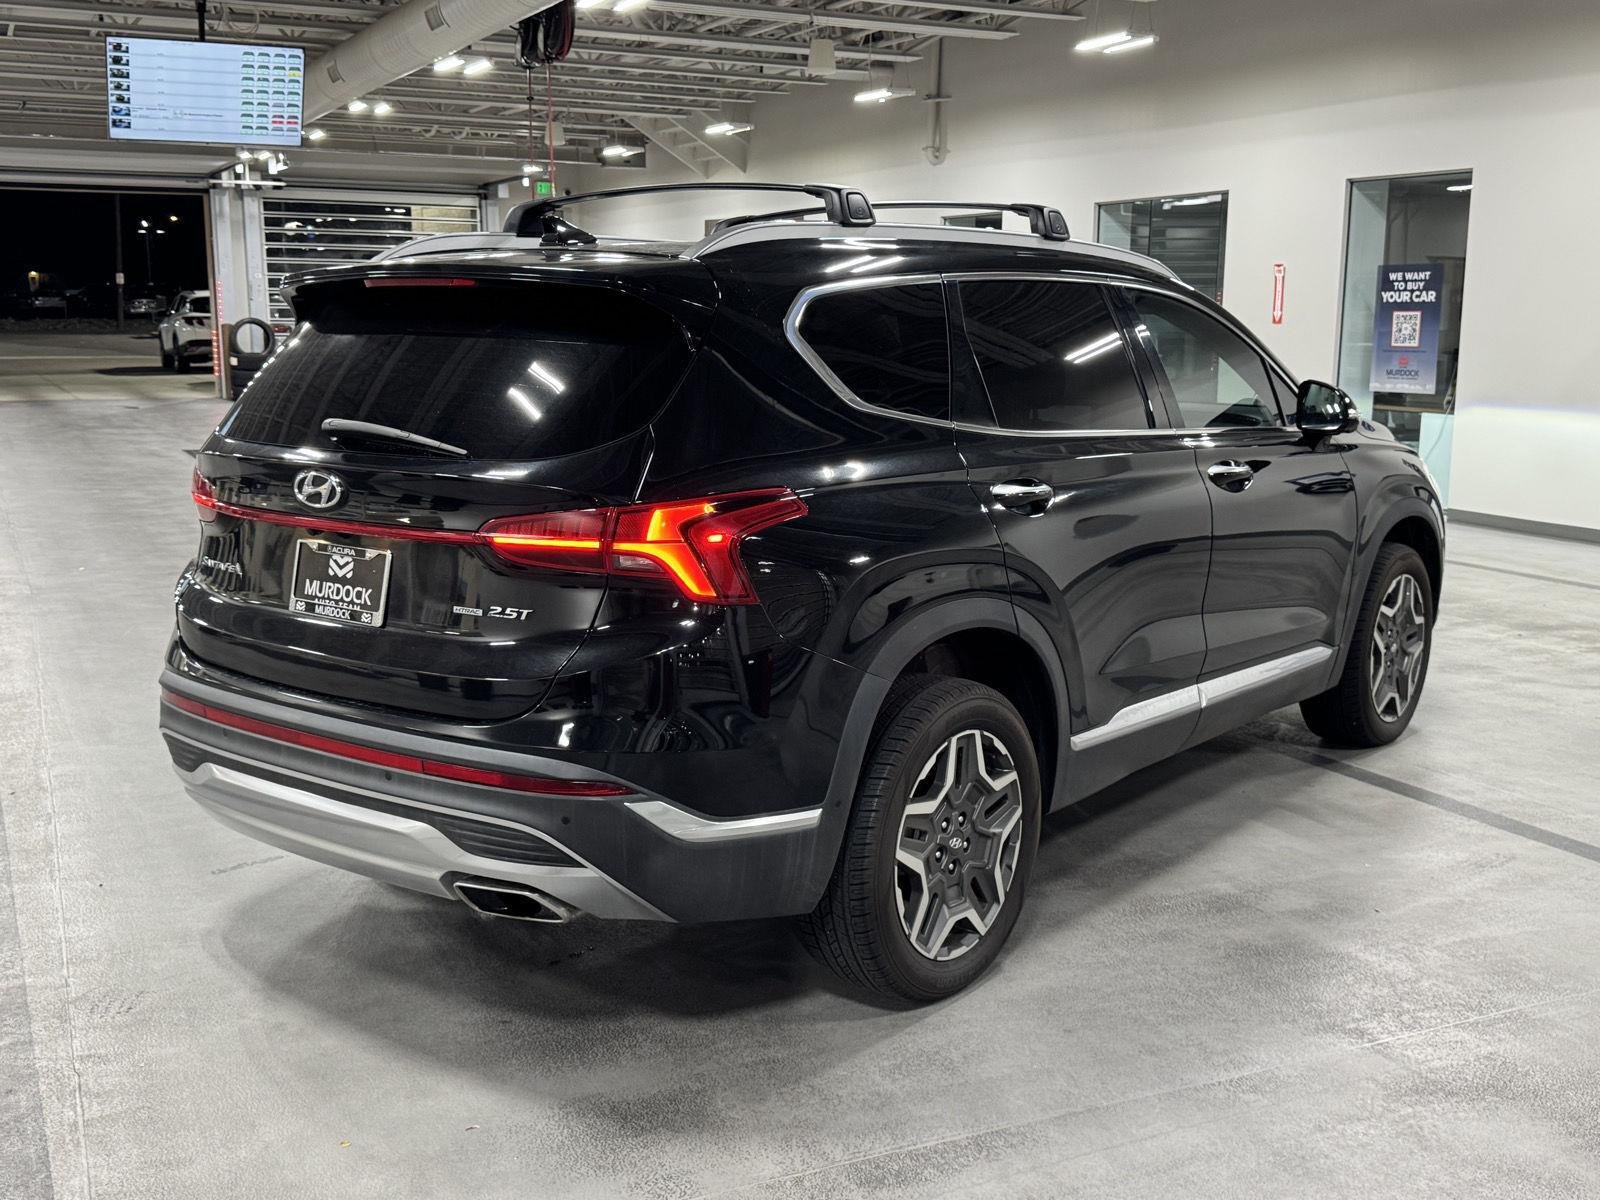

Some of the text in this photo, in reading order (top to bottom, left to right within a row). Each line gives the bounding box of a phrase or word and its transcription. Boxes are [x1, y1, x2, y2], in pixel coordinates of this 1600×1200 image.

[1389, 271, 1431, 281] WE WANT
[1393, 281, 1425, 290] TO BUY
[1381, 290, 1437, 303] YOUR CAR
[332, 546, 356, 556] ACURA
[304, 578, 373, 606] MURDOCK
[314, 604, 351, 620] MURDOCK
[487, 606, 534, 620] 2.5T
